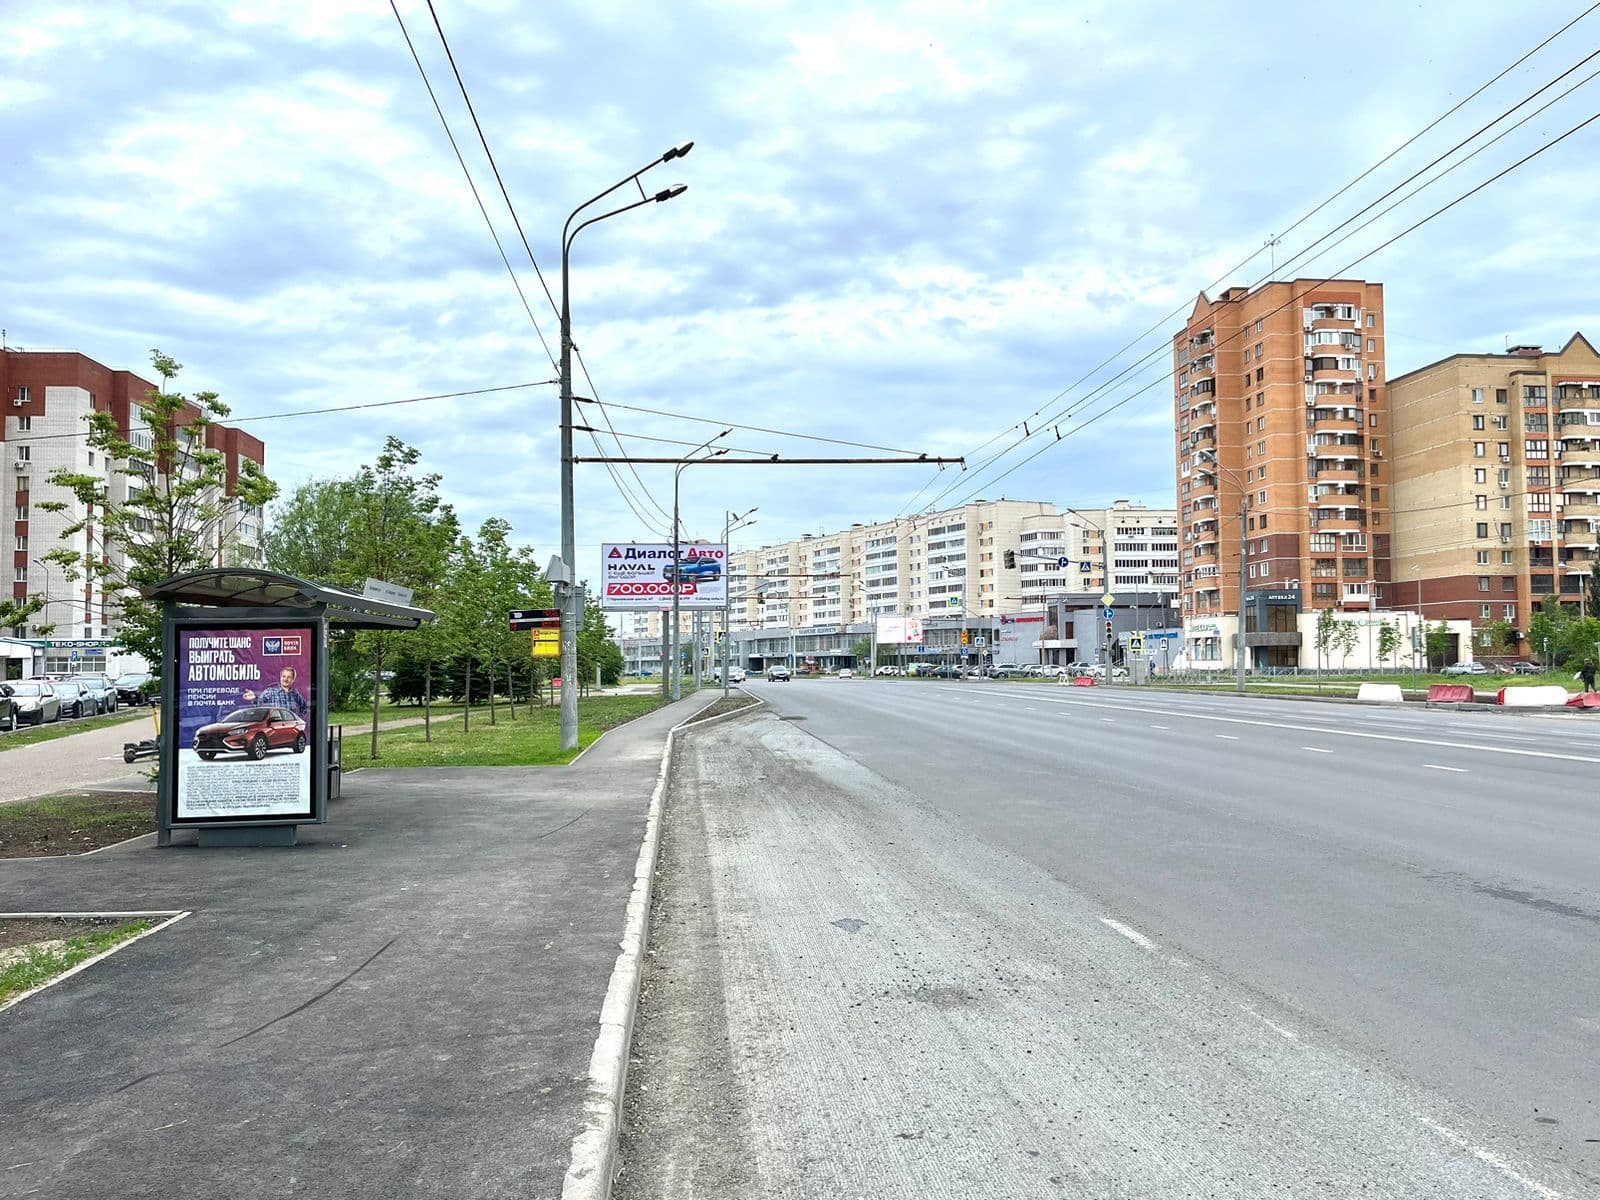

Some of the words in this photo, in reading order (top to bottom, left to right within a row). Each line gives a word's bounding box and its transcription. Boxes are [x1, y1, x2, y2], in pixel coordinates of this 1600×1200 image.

[624, 548, 684, 560] Диалог
[189, 637, 229, 649] ПОЛУЧИТЕ
[229, 637, 252, 649] ШАНС
[189, 650, 235, 664] ВЫИГРАТЬ
[188, 664, 261, 681] АВТОМОБИЛЬ
